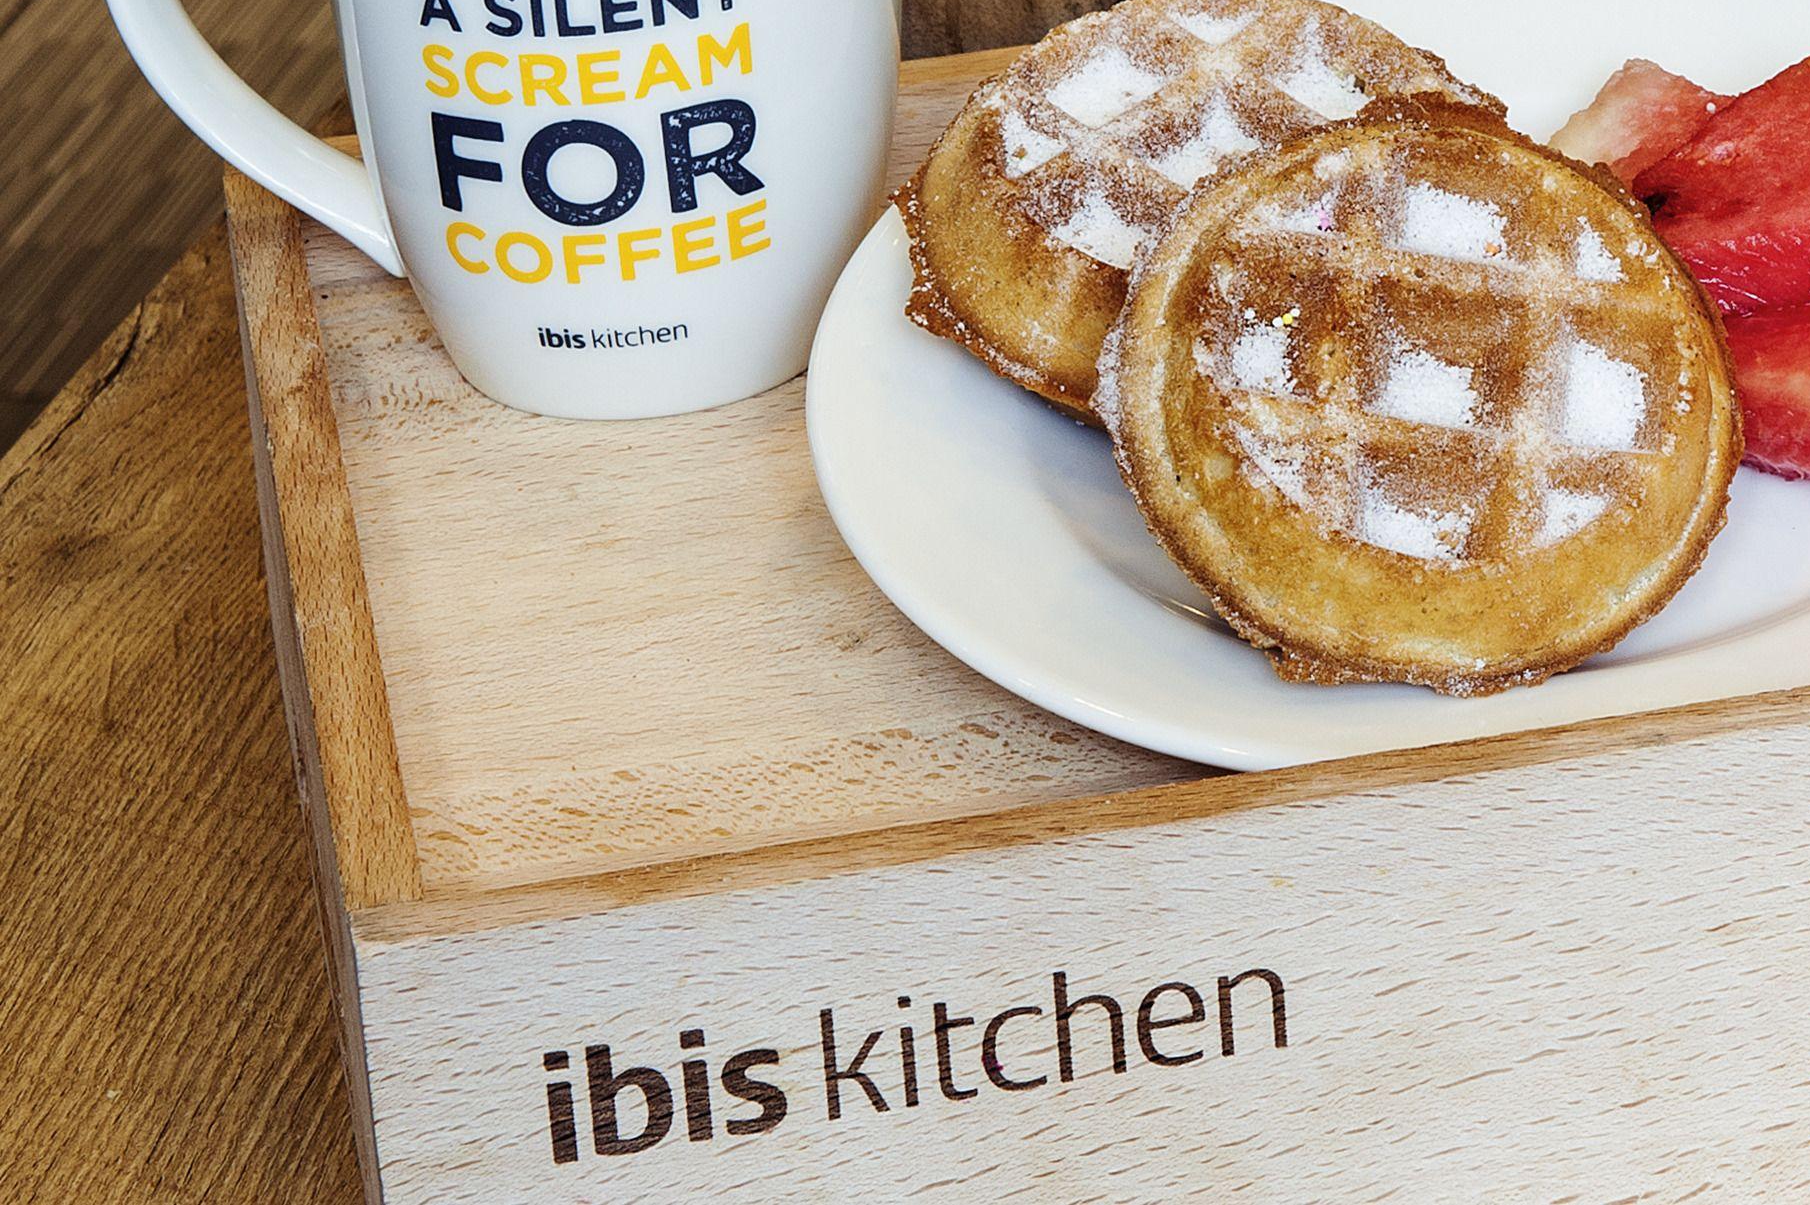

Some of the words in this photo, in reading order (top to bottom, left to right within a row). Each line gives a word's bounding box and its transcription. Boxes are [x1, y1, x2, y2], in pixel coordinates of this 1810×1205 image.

[421, 21, 754, 107] SCREAM
[430, 98, 766, 227] FOR
[445, 198, 773, 285] COFFEE
[537, 326, 587, 350] ibis
[590, 322, 690, 349] kitchen
[542, 1028, 789, 1165] ibis
[819, 968, 1289, 1122] kitchen
